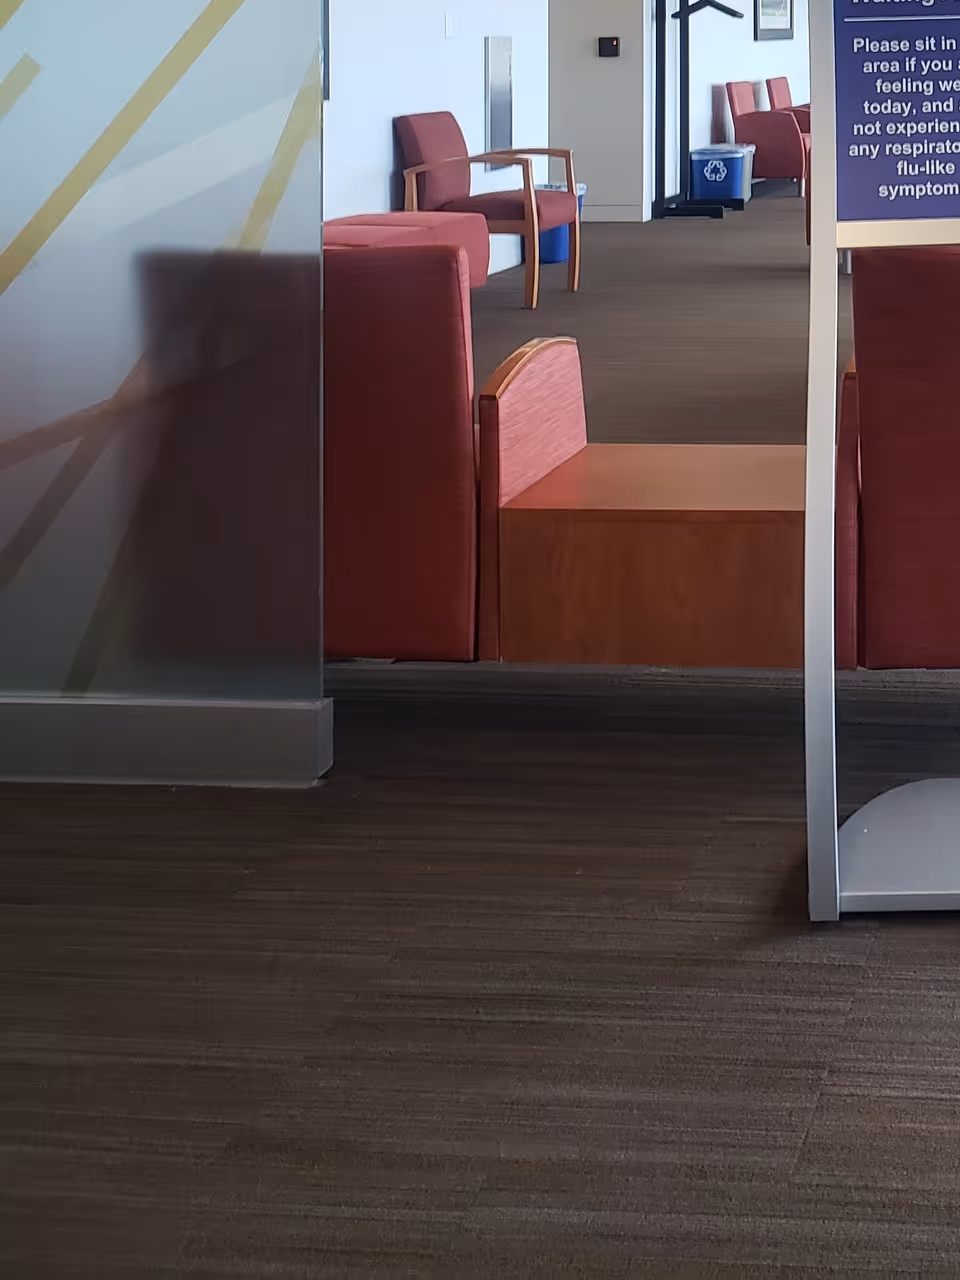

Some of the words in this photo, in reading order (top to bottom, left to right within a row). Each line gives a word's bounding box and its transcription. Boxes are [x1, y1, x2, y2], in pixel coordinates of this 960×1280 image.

[853, 37, 910, 53] Please
[915, 36, 936, 52] sit
[941, 35, 957, 51] in
[863, 60, 900, 73] area
[905, 56, 917, 72] if
[920, 60, 953, 76] you
[875, 77, 934, 96] feeling
[863, 98, 917, 117] today,
[921, 97, 954, 113] and
[853, 120, 882, 136] not
[848, 144, 880, 160] any
[896, 159, 956, 176] flu-like
